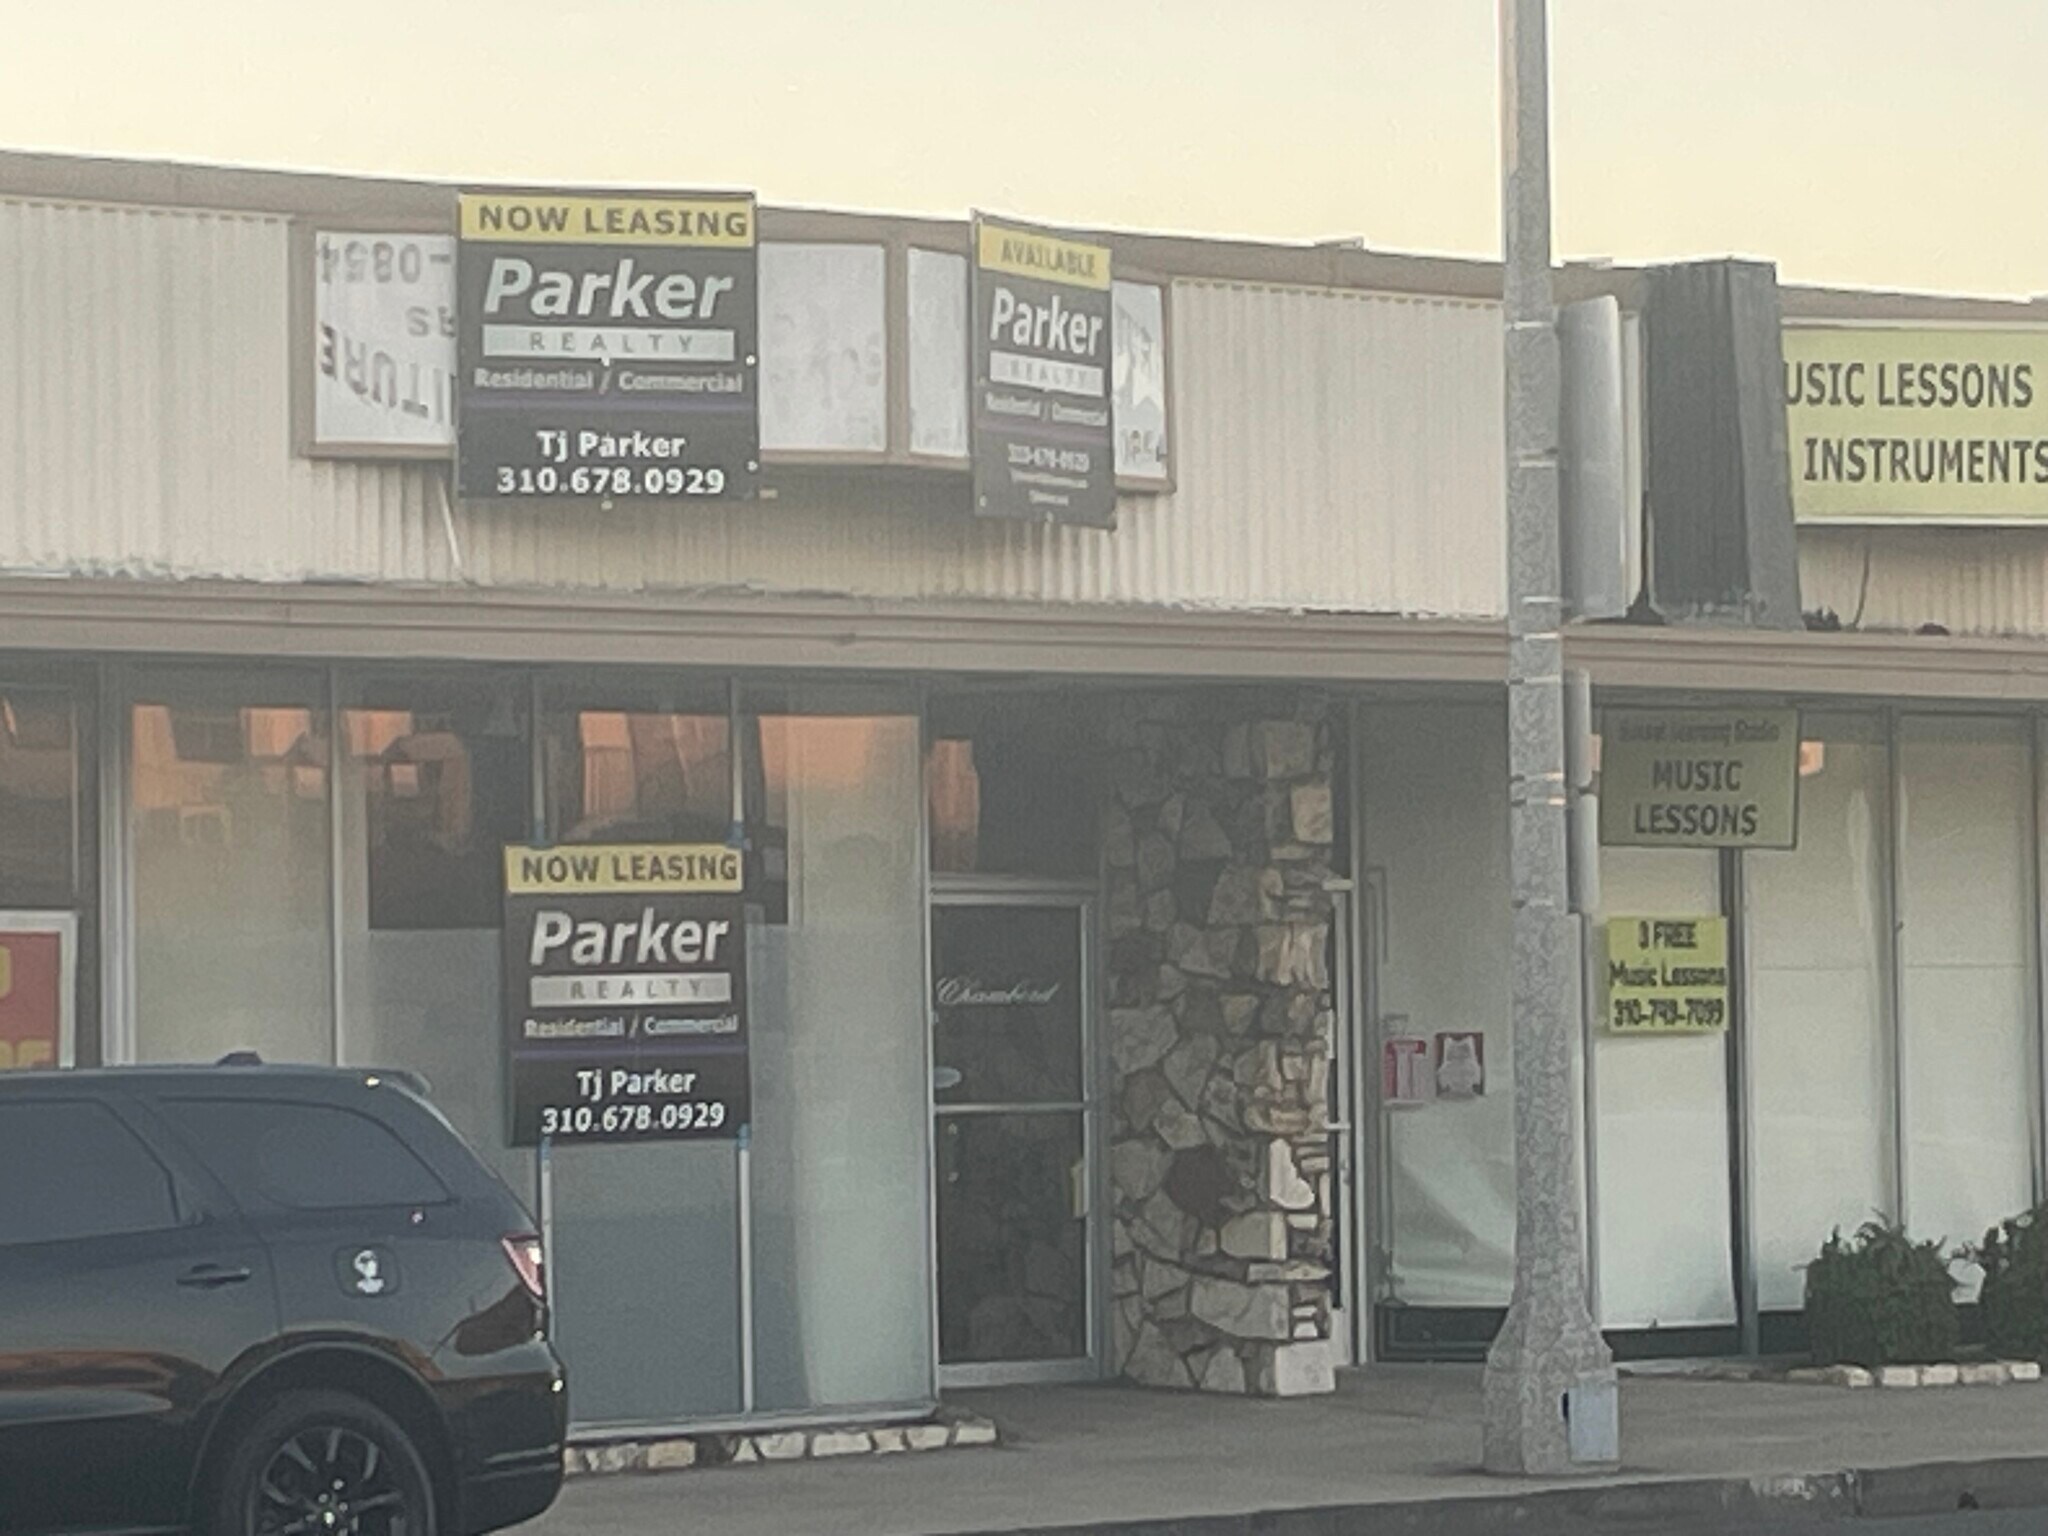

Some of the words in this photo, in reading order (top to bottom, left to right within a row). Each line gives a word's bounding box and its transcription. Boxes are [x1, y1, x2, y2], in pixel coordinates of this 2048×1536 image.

[478, 203, 568, 233] NOW
[584, 207, 747, 237] LEASING
[1001, 239, 1096, 278] AVAILABLE
[483, 258, 734, 319] Parker
[990, 287, 1102, 355] Parker
[530, 332, 695, 354] REALTY
[320, 322, 457, 426] ITURE
[474, 368, 593, 390] Residential
[618, 370, 742, 393] Commercial
[1877, 363, 2033, 408] LESSONS
[536, 431, 569, 463] Tj
[578, 431, 686, 458] Parker
[1803, 437, 2048, 483] INSTRUMENTS
[497, 467, 725, 495] 310.678.0929
[1653, 760, 1742, 792] MUSIC
[1635, 803, 1757, 836] LESSONS
[522, 855, 599, 883] NOW
[612, 854, 738, 881] LEASING
[530, 907, 729, 966] Parker
[1653, 921, 1697, 949] FREE
[570, 977, 704, 1000] REALTY
[1609, 959, 1657, 989] Music
[1661, 959, 1725, 987] Lessons
[576, 1068, 603, 1101] Tj
[611, 1069, 695, 1096] Parker
[541, 1102, 725, 1135] 310.678.0929
